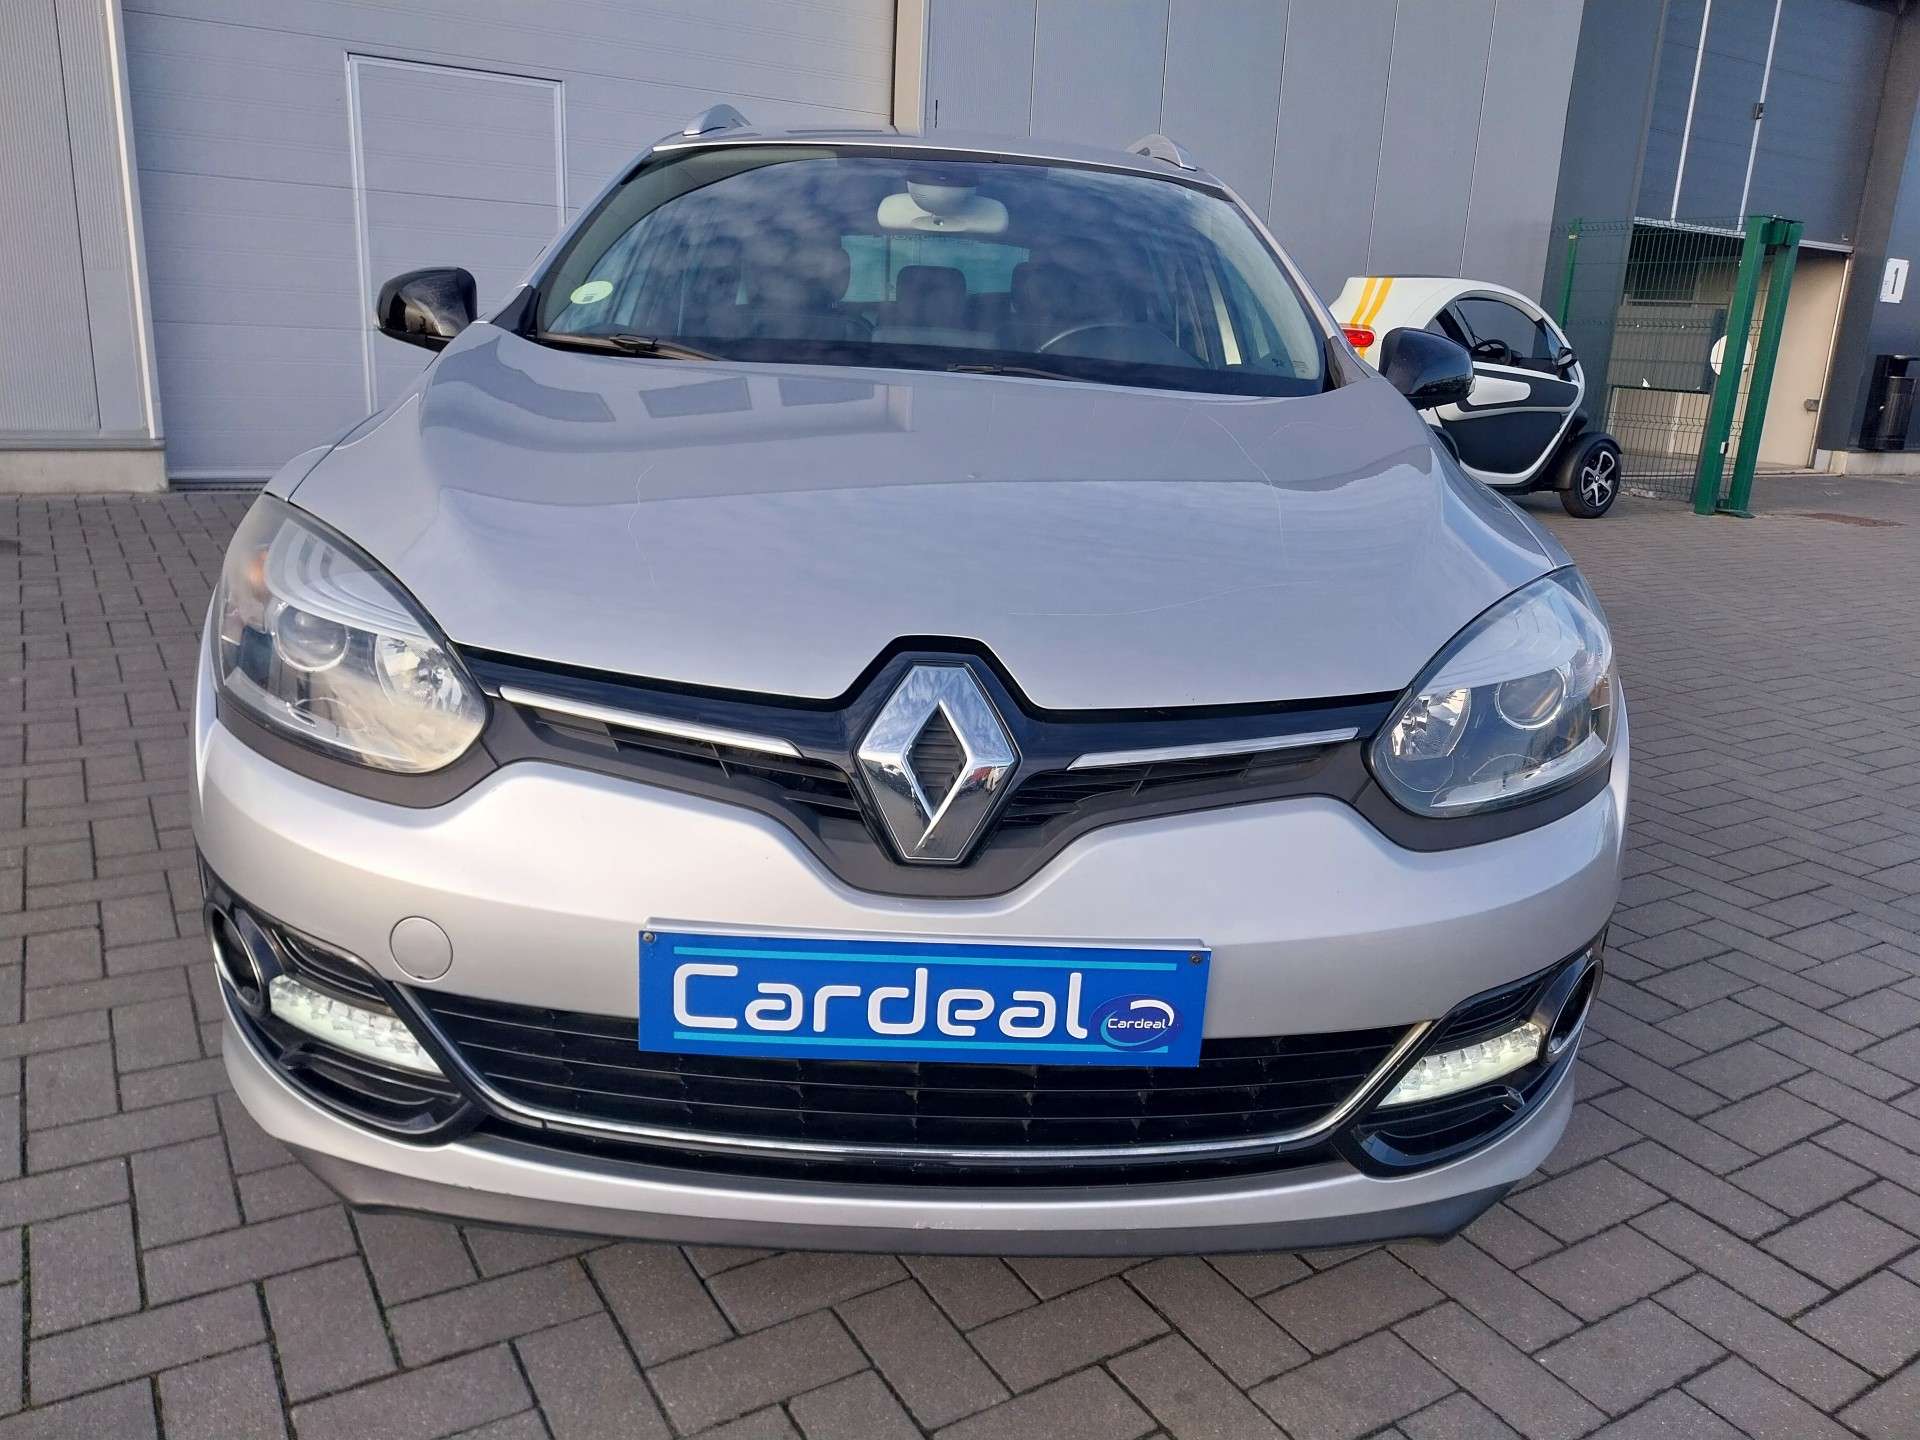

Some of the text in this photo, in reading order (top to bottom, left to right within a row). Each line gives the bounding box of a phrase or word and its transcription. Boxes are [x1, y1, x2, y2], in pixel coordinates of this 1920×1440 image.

[1891, 267, 1899, 294] 1
[673, 963, 1088, 1039] Cardeal
[1107, 1017, 1167, 1030] Cardeal
